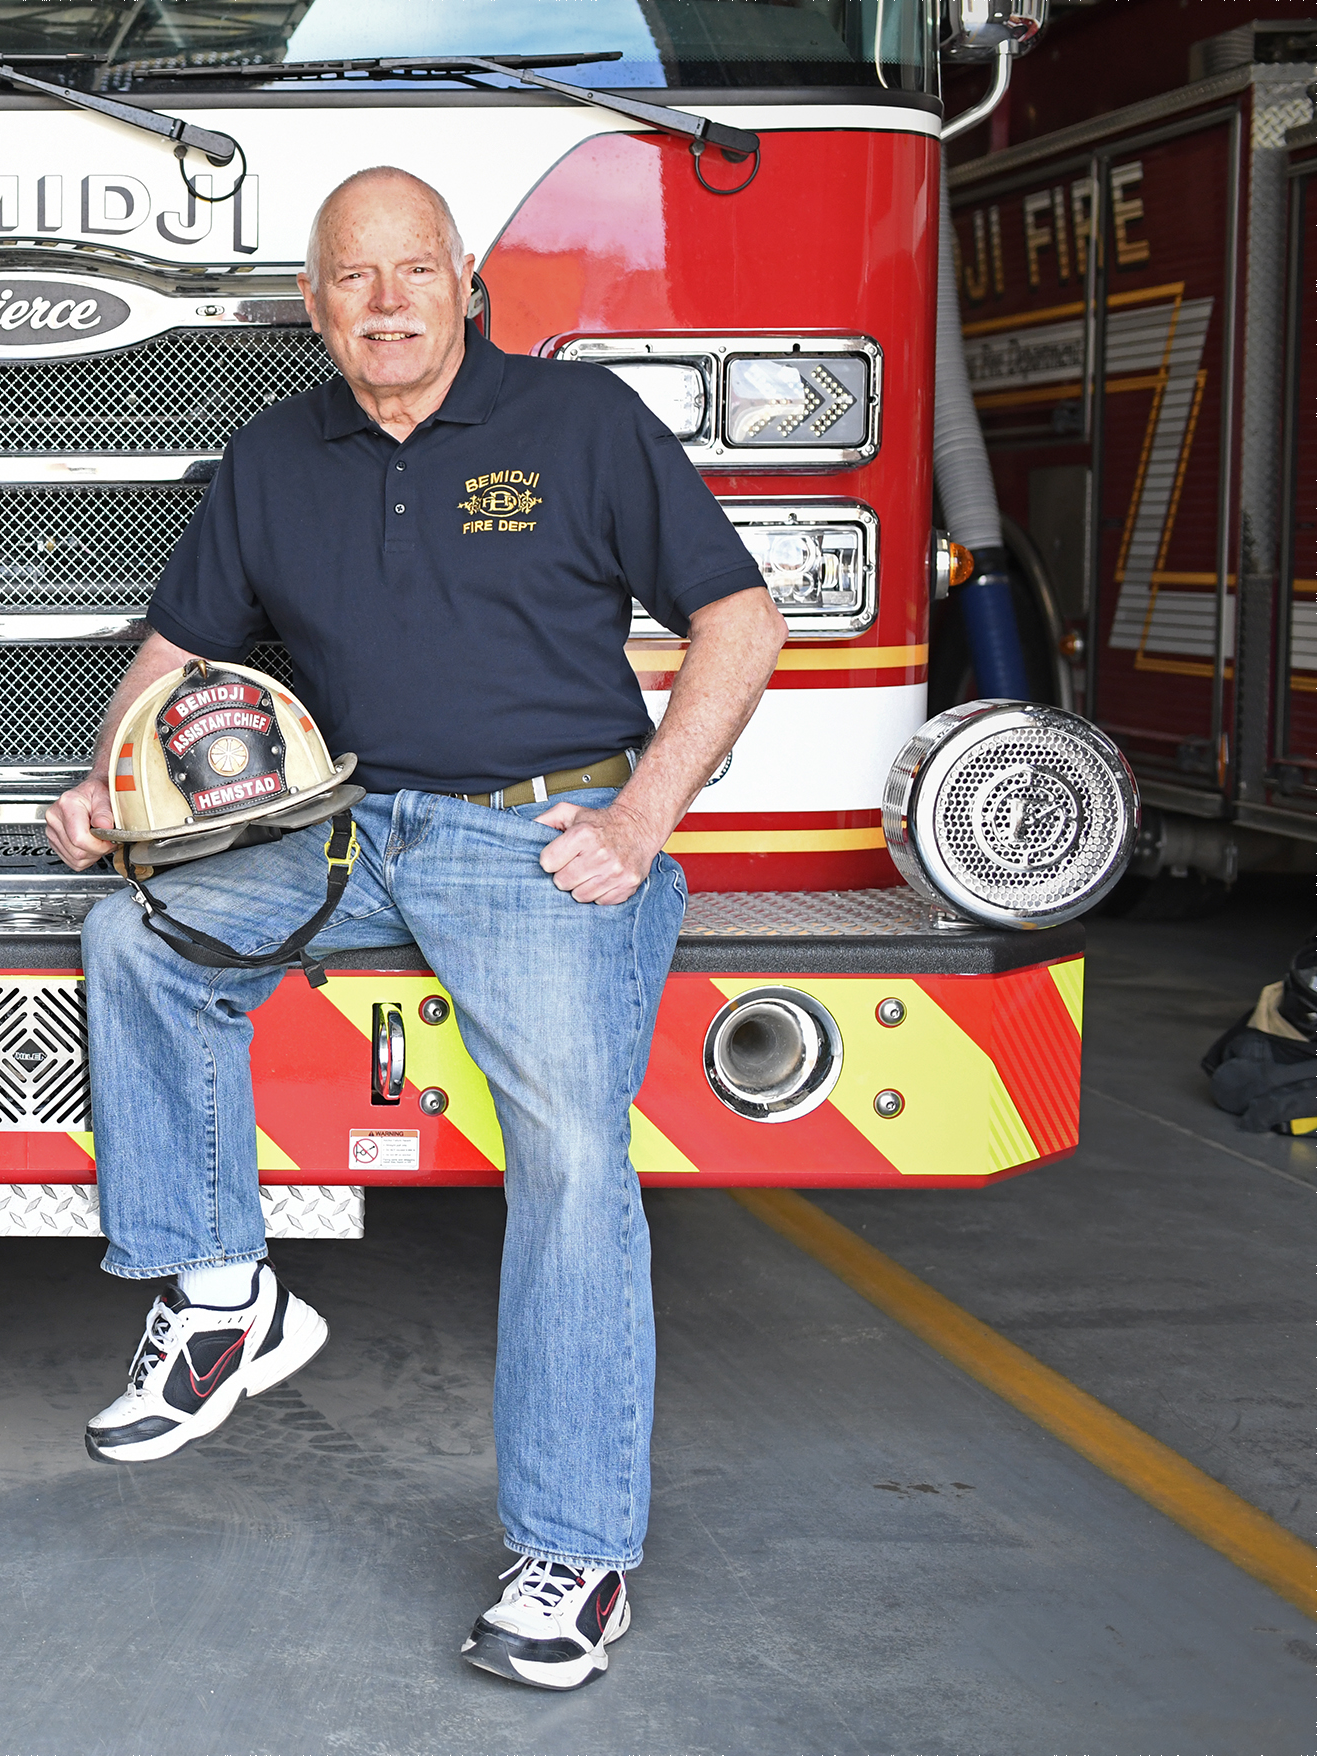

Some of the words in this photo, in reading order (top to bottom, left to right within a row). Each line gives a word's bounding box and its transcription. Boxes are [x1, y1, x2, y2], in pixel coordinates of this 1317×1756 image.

[950, 204, 1005, 300] JI
[1025, 160, 1151, 286] FIRE
[465, 469, 540, 493] BEMIDJI
[463, 520, 494, 535] FIRE
[498, 519, 537, 532] DEPT
[175, 686, 245, 718] BEMIDJI
[172, 712, 233, 753] ASSISTANT
[233, 711, 267, 730] CHIEF
[198, 776, 276, 810] HEMSTAD
